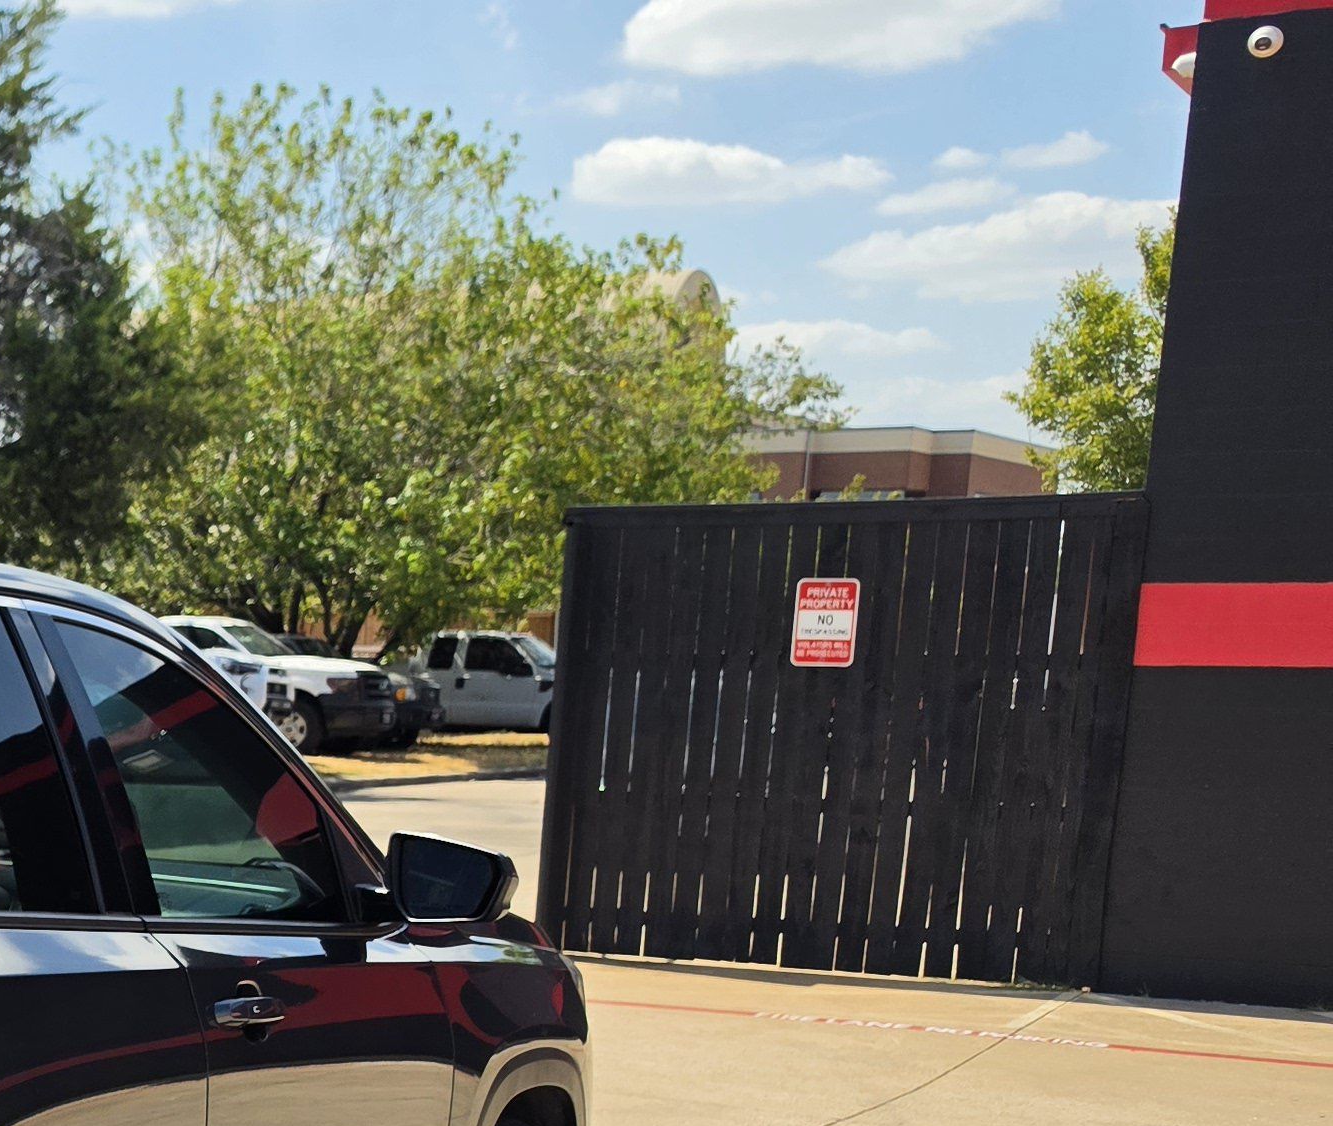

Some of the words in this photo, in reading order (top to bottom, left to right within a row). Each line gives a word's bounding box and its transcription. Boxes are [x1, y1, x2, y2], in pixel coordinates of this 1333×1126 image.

[806, 587, 850, 598] PRIVATE
[799, 599, 854, 609] PROPERTY
[817, 614, 834, 626] NO
